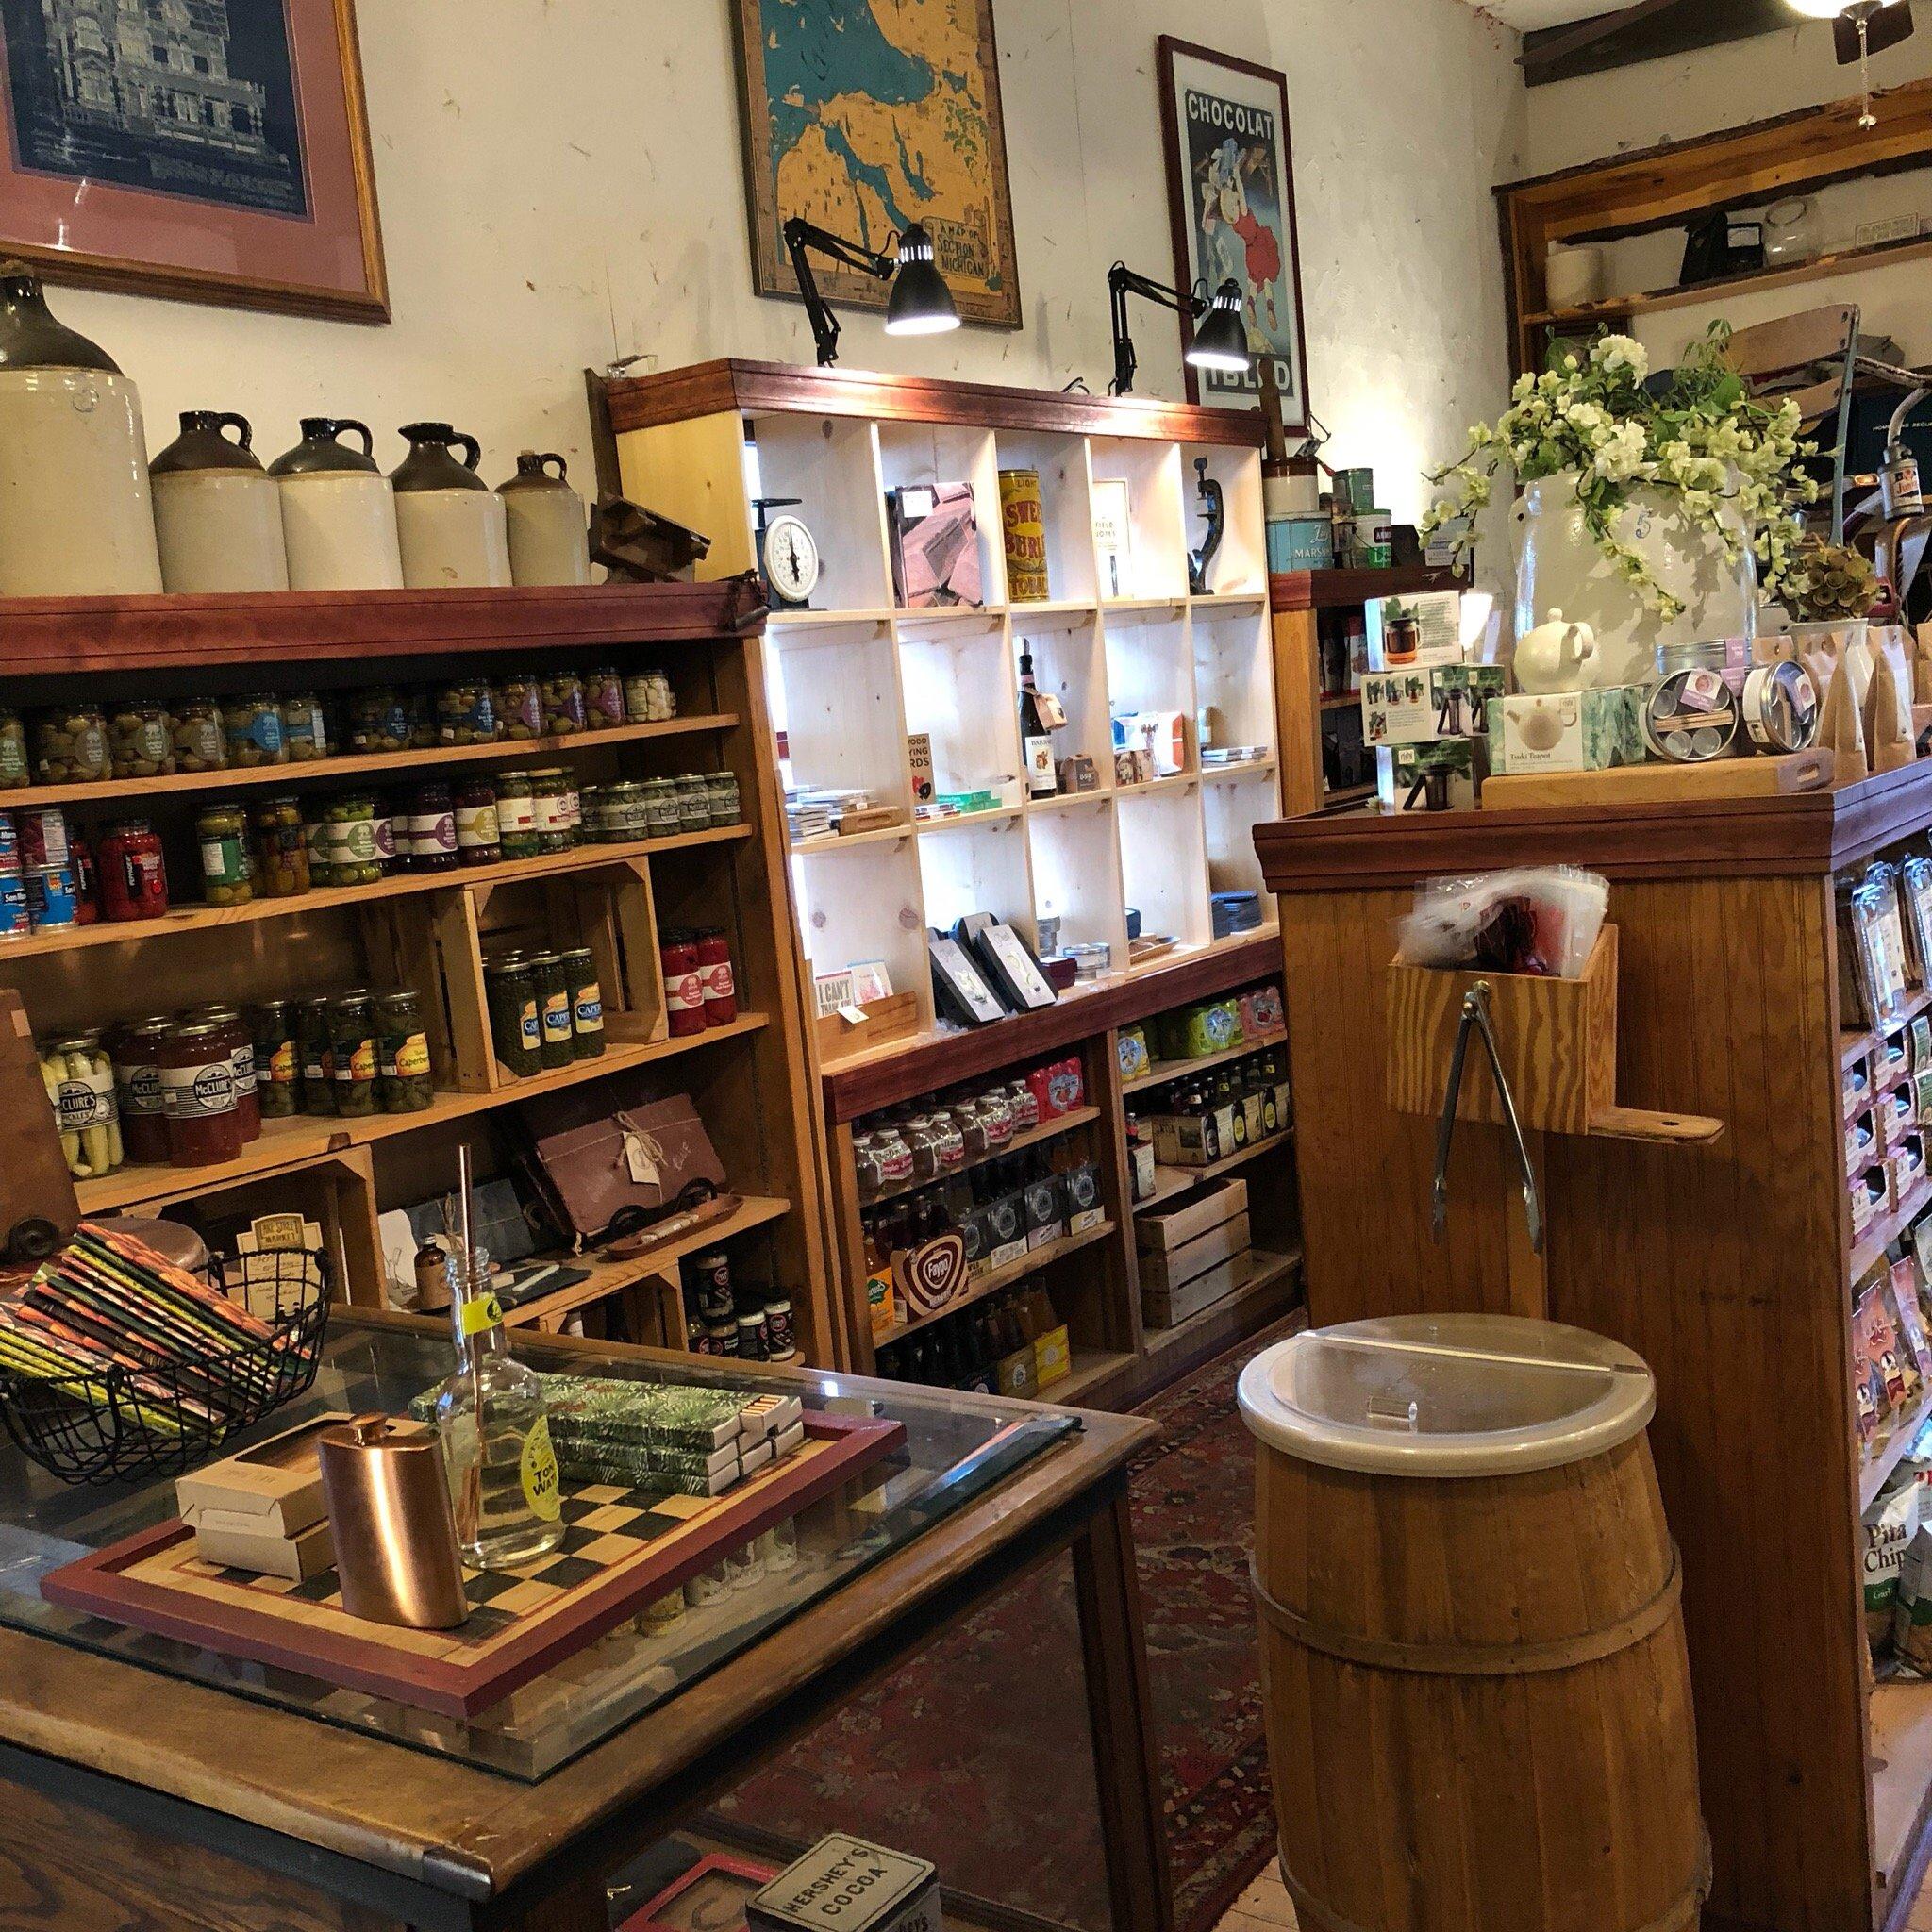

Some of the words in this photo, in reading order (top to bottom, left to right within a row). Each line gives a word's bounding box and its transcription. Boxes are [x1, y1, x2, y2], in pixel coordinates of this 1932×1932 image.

[1189, 92, 1272, 140] CHOCOLAT
[937, 234, 974, 258] SECTION
[941, 254, 985, 276] MICHIGAN
[1211, 358, 1290, 391] IBLD
[927, 1257, 950, 1279] Faygo
[1862, 1523, 1907, 1549] Pita
[821, 1867, 888, 1917] COCOA
